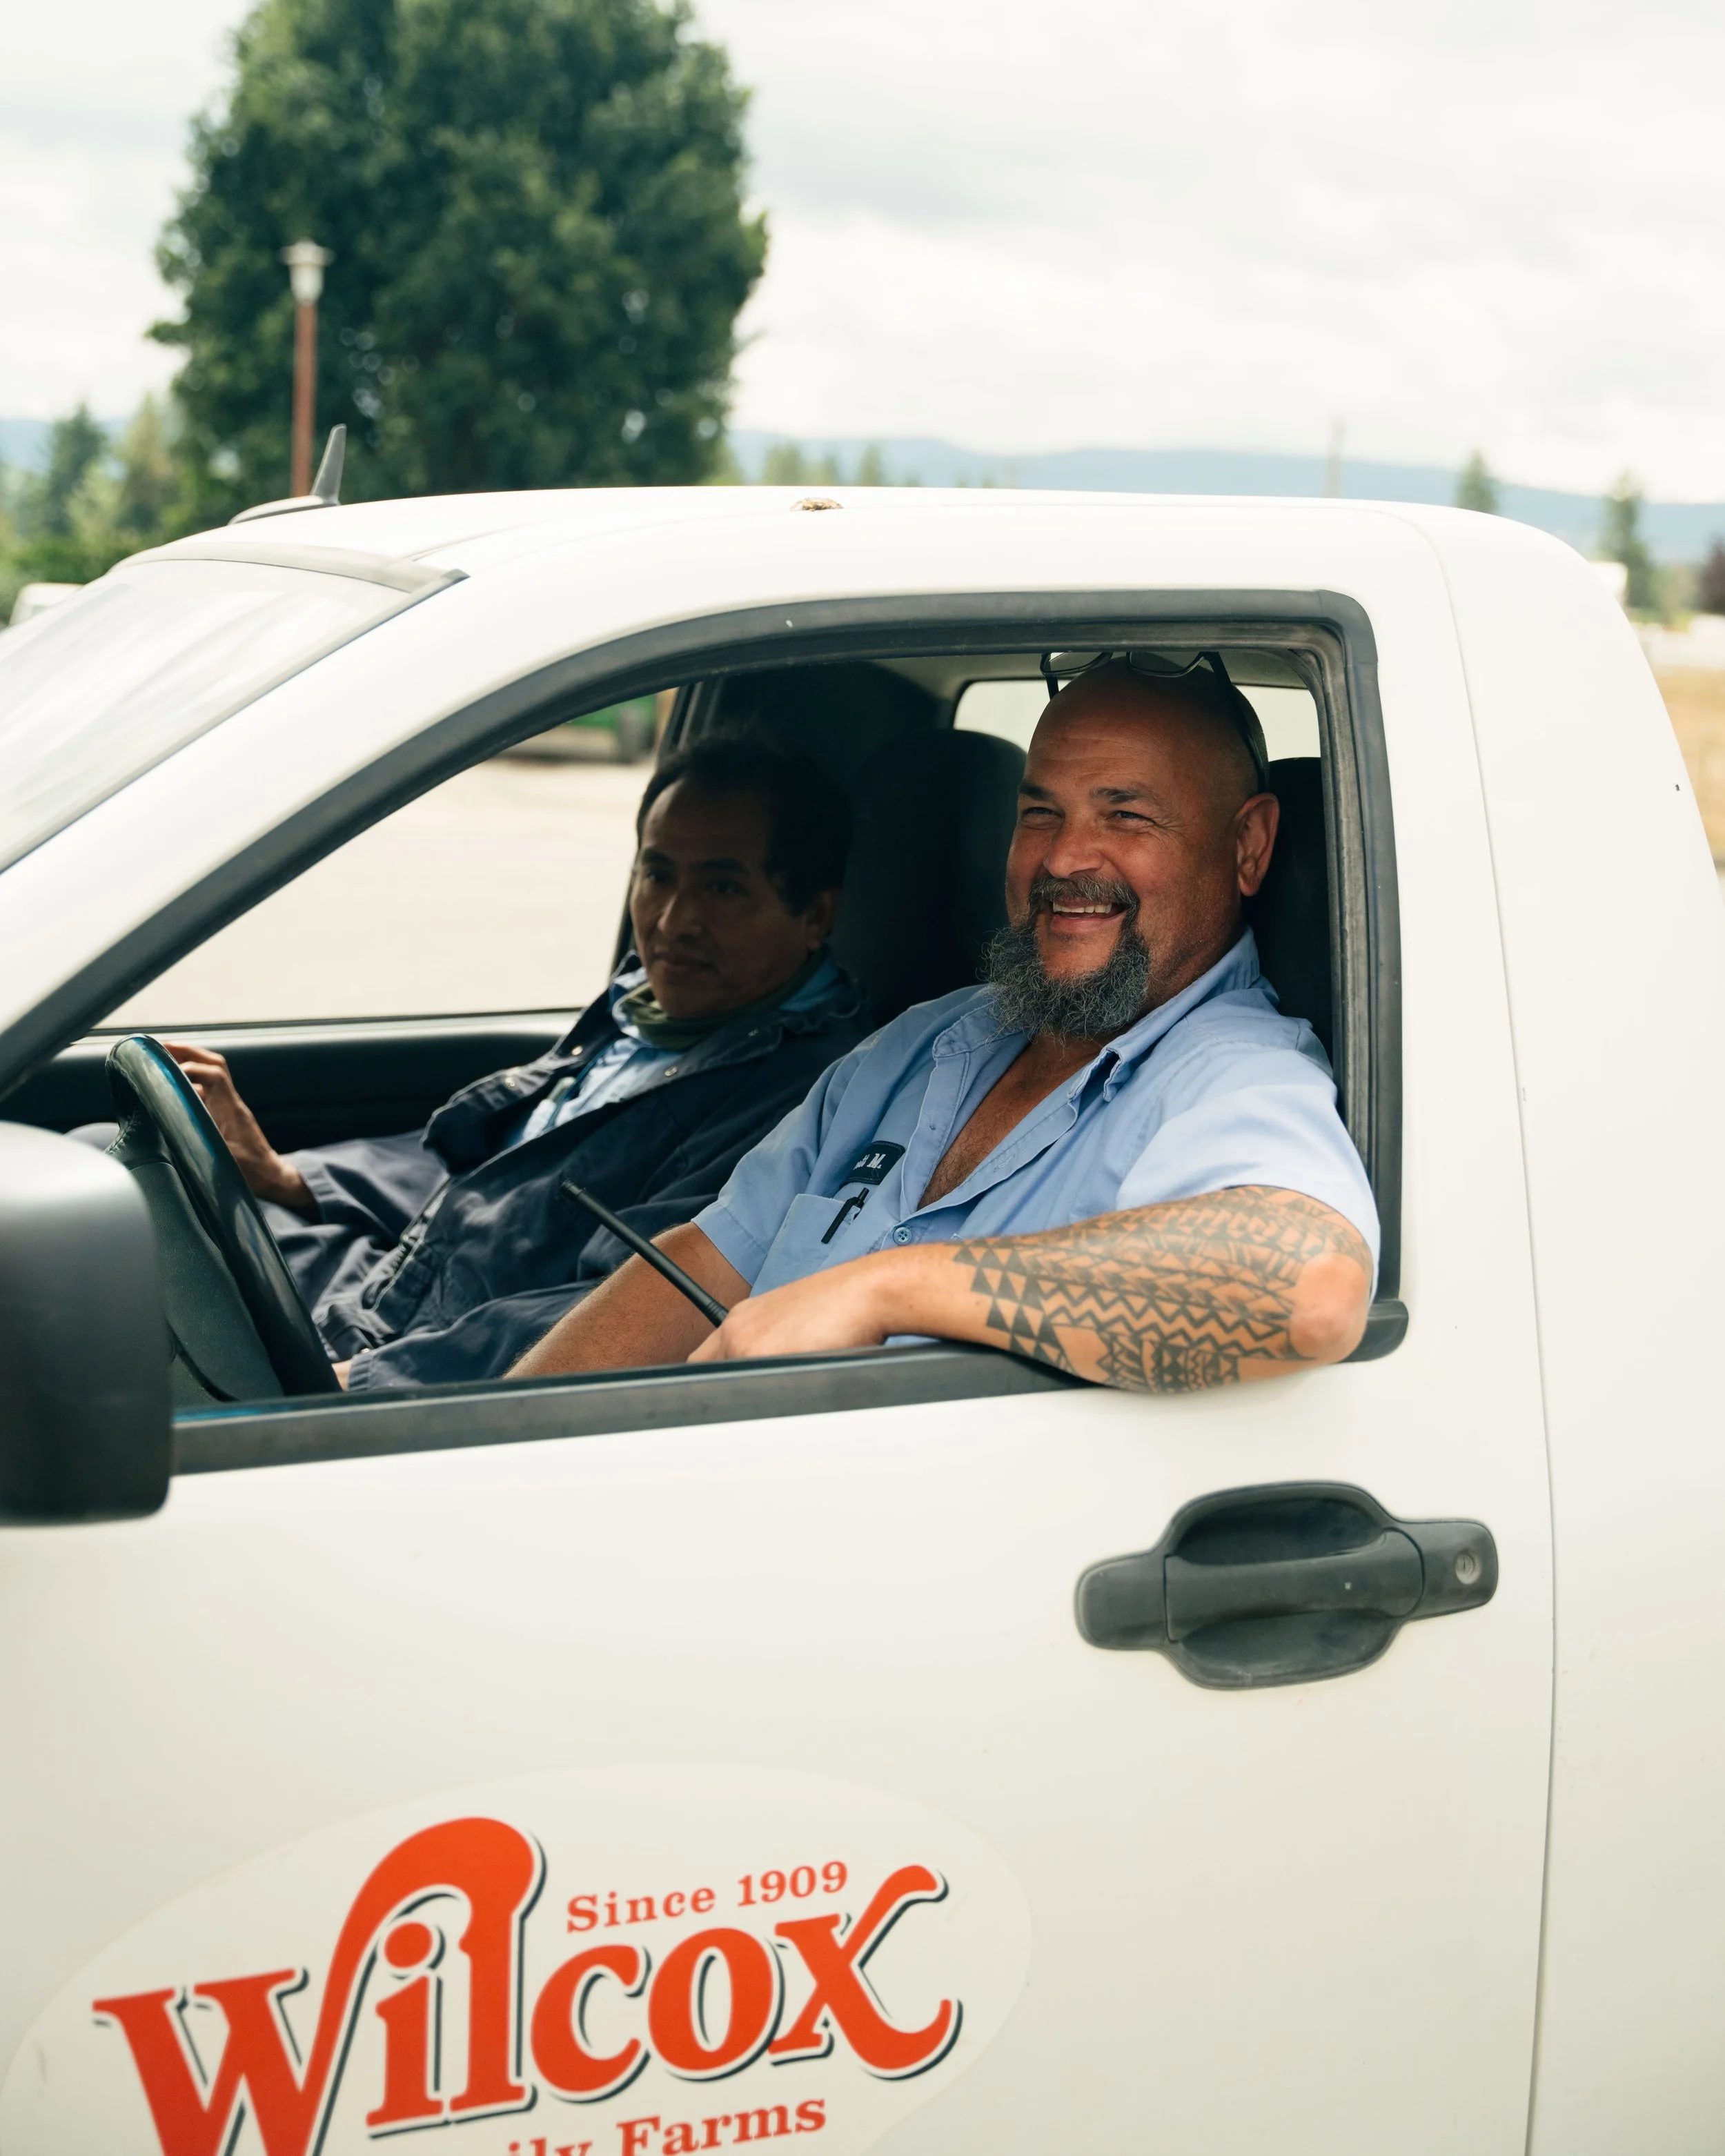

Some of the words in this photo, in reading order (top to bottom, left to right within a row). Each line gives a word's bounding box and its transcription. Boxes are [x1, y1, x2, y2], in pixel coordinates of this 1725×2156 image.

[566, 1887, 716, 1933] Since
[738, 1861, 848, 1907] 1909
[92, 1817, 962, 2156] Wilcox
[616, 2098, 827, 2156] Farms
